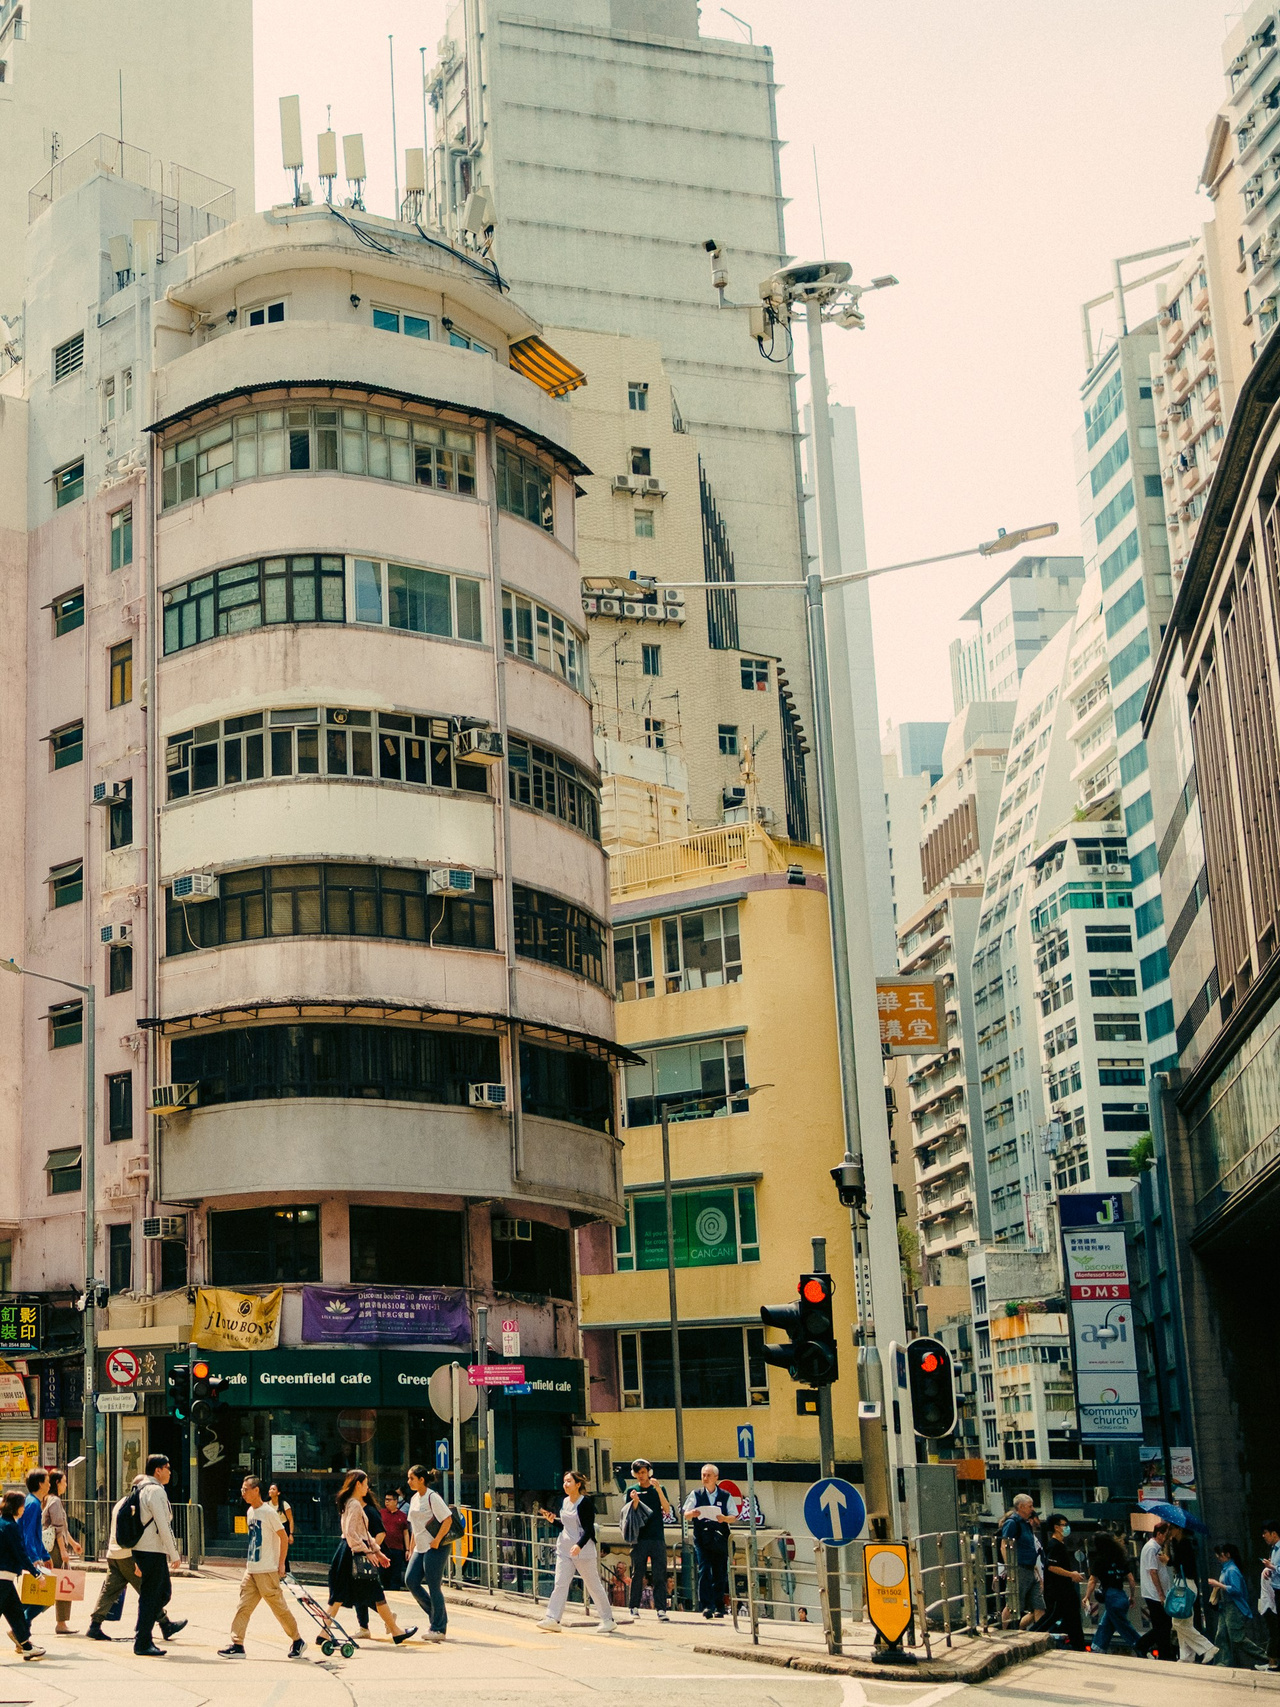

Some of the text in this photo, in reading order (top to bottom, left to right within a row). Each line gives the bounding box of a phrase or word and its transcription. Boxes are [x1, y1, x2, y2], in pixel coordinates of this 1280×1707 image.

[691, 1247, 730, 1259] CANCAN
[383, 1292, 401, 1300] books
[419, 1293, 432, 1301] Free
[0, 1306, 18, 1340] 釘裝
[19, 1307, 37, 1340] 影印
[1081, 1316, 1127, 1349] api
[503, 1334, 514, 1355] 中環
[225, 1373, 248, 1385] cafe
[260, 1372, 372, 1384] Greenfield cafe
[48, 1368, 56, 1408] BOOKS
[555, 1382, 572, 1392] cafe
[1083, 1406, 1139, 1418] community
[1093, 1415, 1129, 1425] church
[876, 1588, 902, 1596] TB1502
